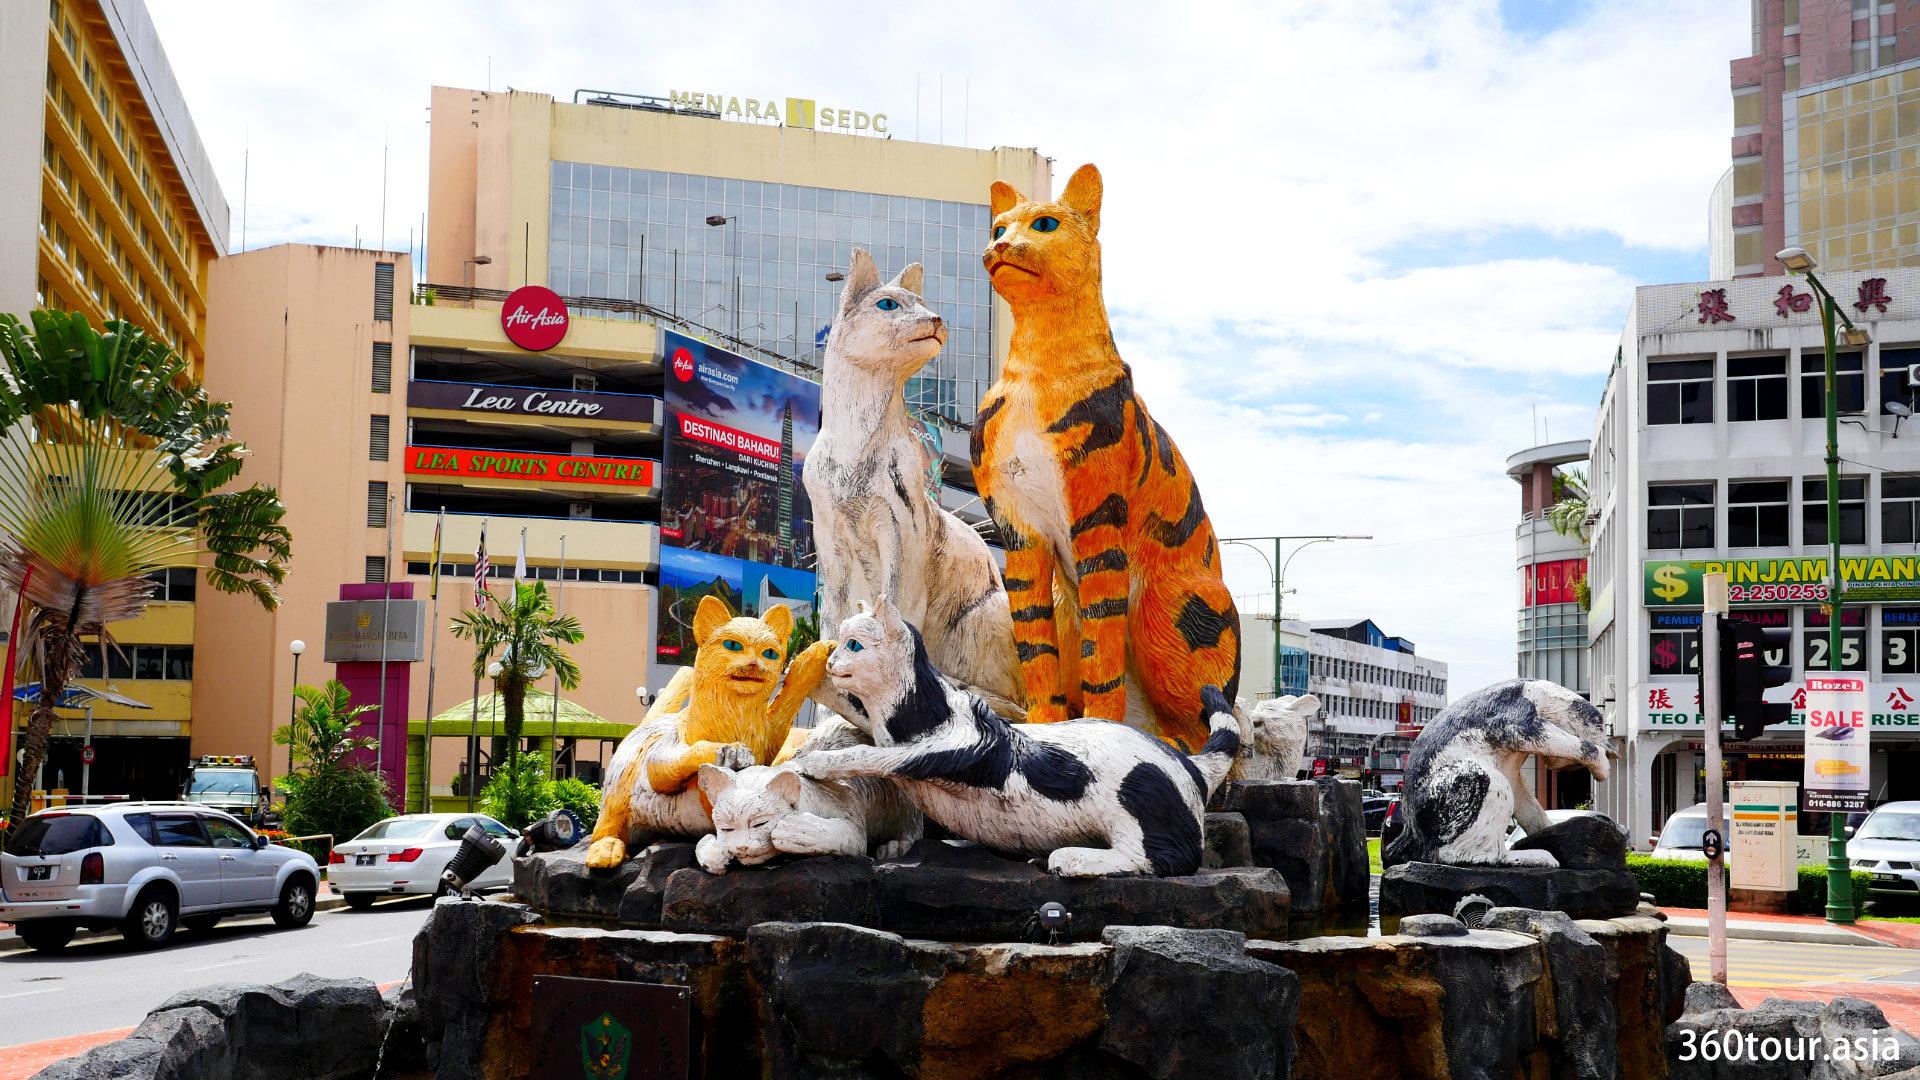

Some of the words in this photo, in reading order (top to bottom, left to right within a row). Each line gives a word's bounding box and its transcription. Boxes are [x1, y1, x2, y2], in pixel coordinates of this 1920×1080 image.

[669, 90, 780, 121] MENARA
[820, 107, 888, 133] SEDC
[698, 363, 739, 385] airasia.com
[461, 388, 516, 411] Lea
[522, 391, 604, 417] Centre
[684, 420, 736, 447] DESTINASI
[737, 435, 780, 459] BAHARU!
[415, 452, 460, 470] LEA
[468, 454, 548, 476] SPORTS
[557, 459, 645, 481] CENTRE
[695, 454, 721, 467] Shenzhen
[725, 462, 750, 475] Langkawi
[753, 470, 778, 483] Pontianak
[738, 454, 753, 464] DARI
[753, 458, 779, 471] KUCHING
[1839, 557, 1920, 581] WAN
[1648, 713, 1689, 725] TEO
[1810, 710, 1864, 728] SALE
[1808, 800, 1842, 808] 016-886
[1844, 800, 1865, 808] 3287
